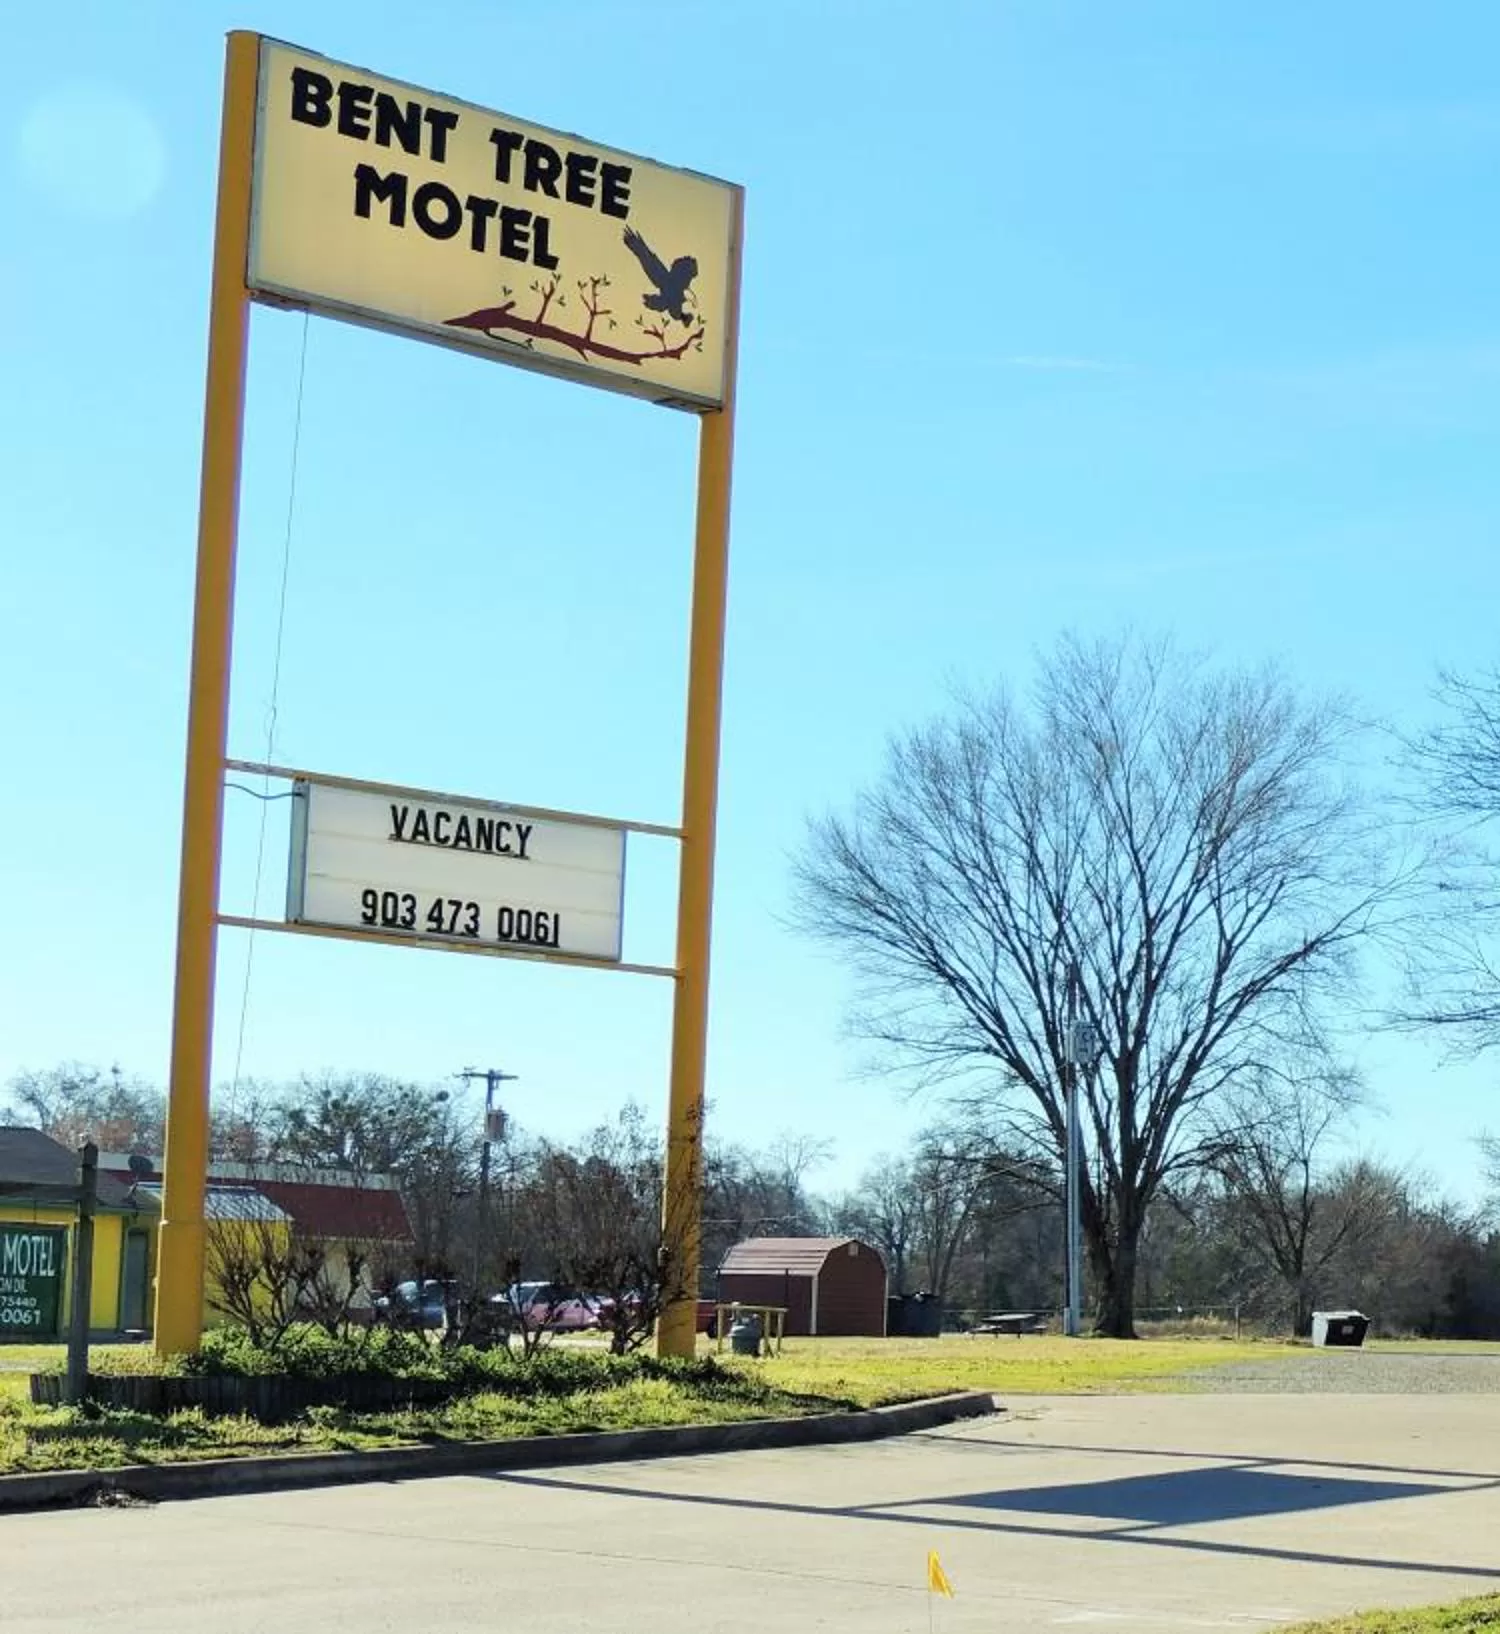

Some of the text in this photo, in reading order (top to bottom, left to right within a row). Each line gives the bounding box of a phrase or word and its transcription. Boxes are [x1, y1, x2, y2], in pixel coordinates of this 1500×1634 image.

[290, 67, 633, 220] BENT TREE
[353, 162, 560, 271] MOTEL
[390, 804, 532, 858] VACANCY
[361, 888, 560, 947] 903 473 0061
[3, 1233, 55, 1277] MOTEL
